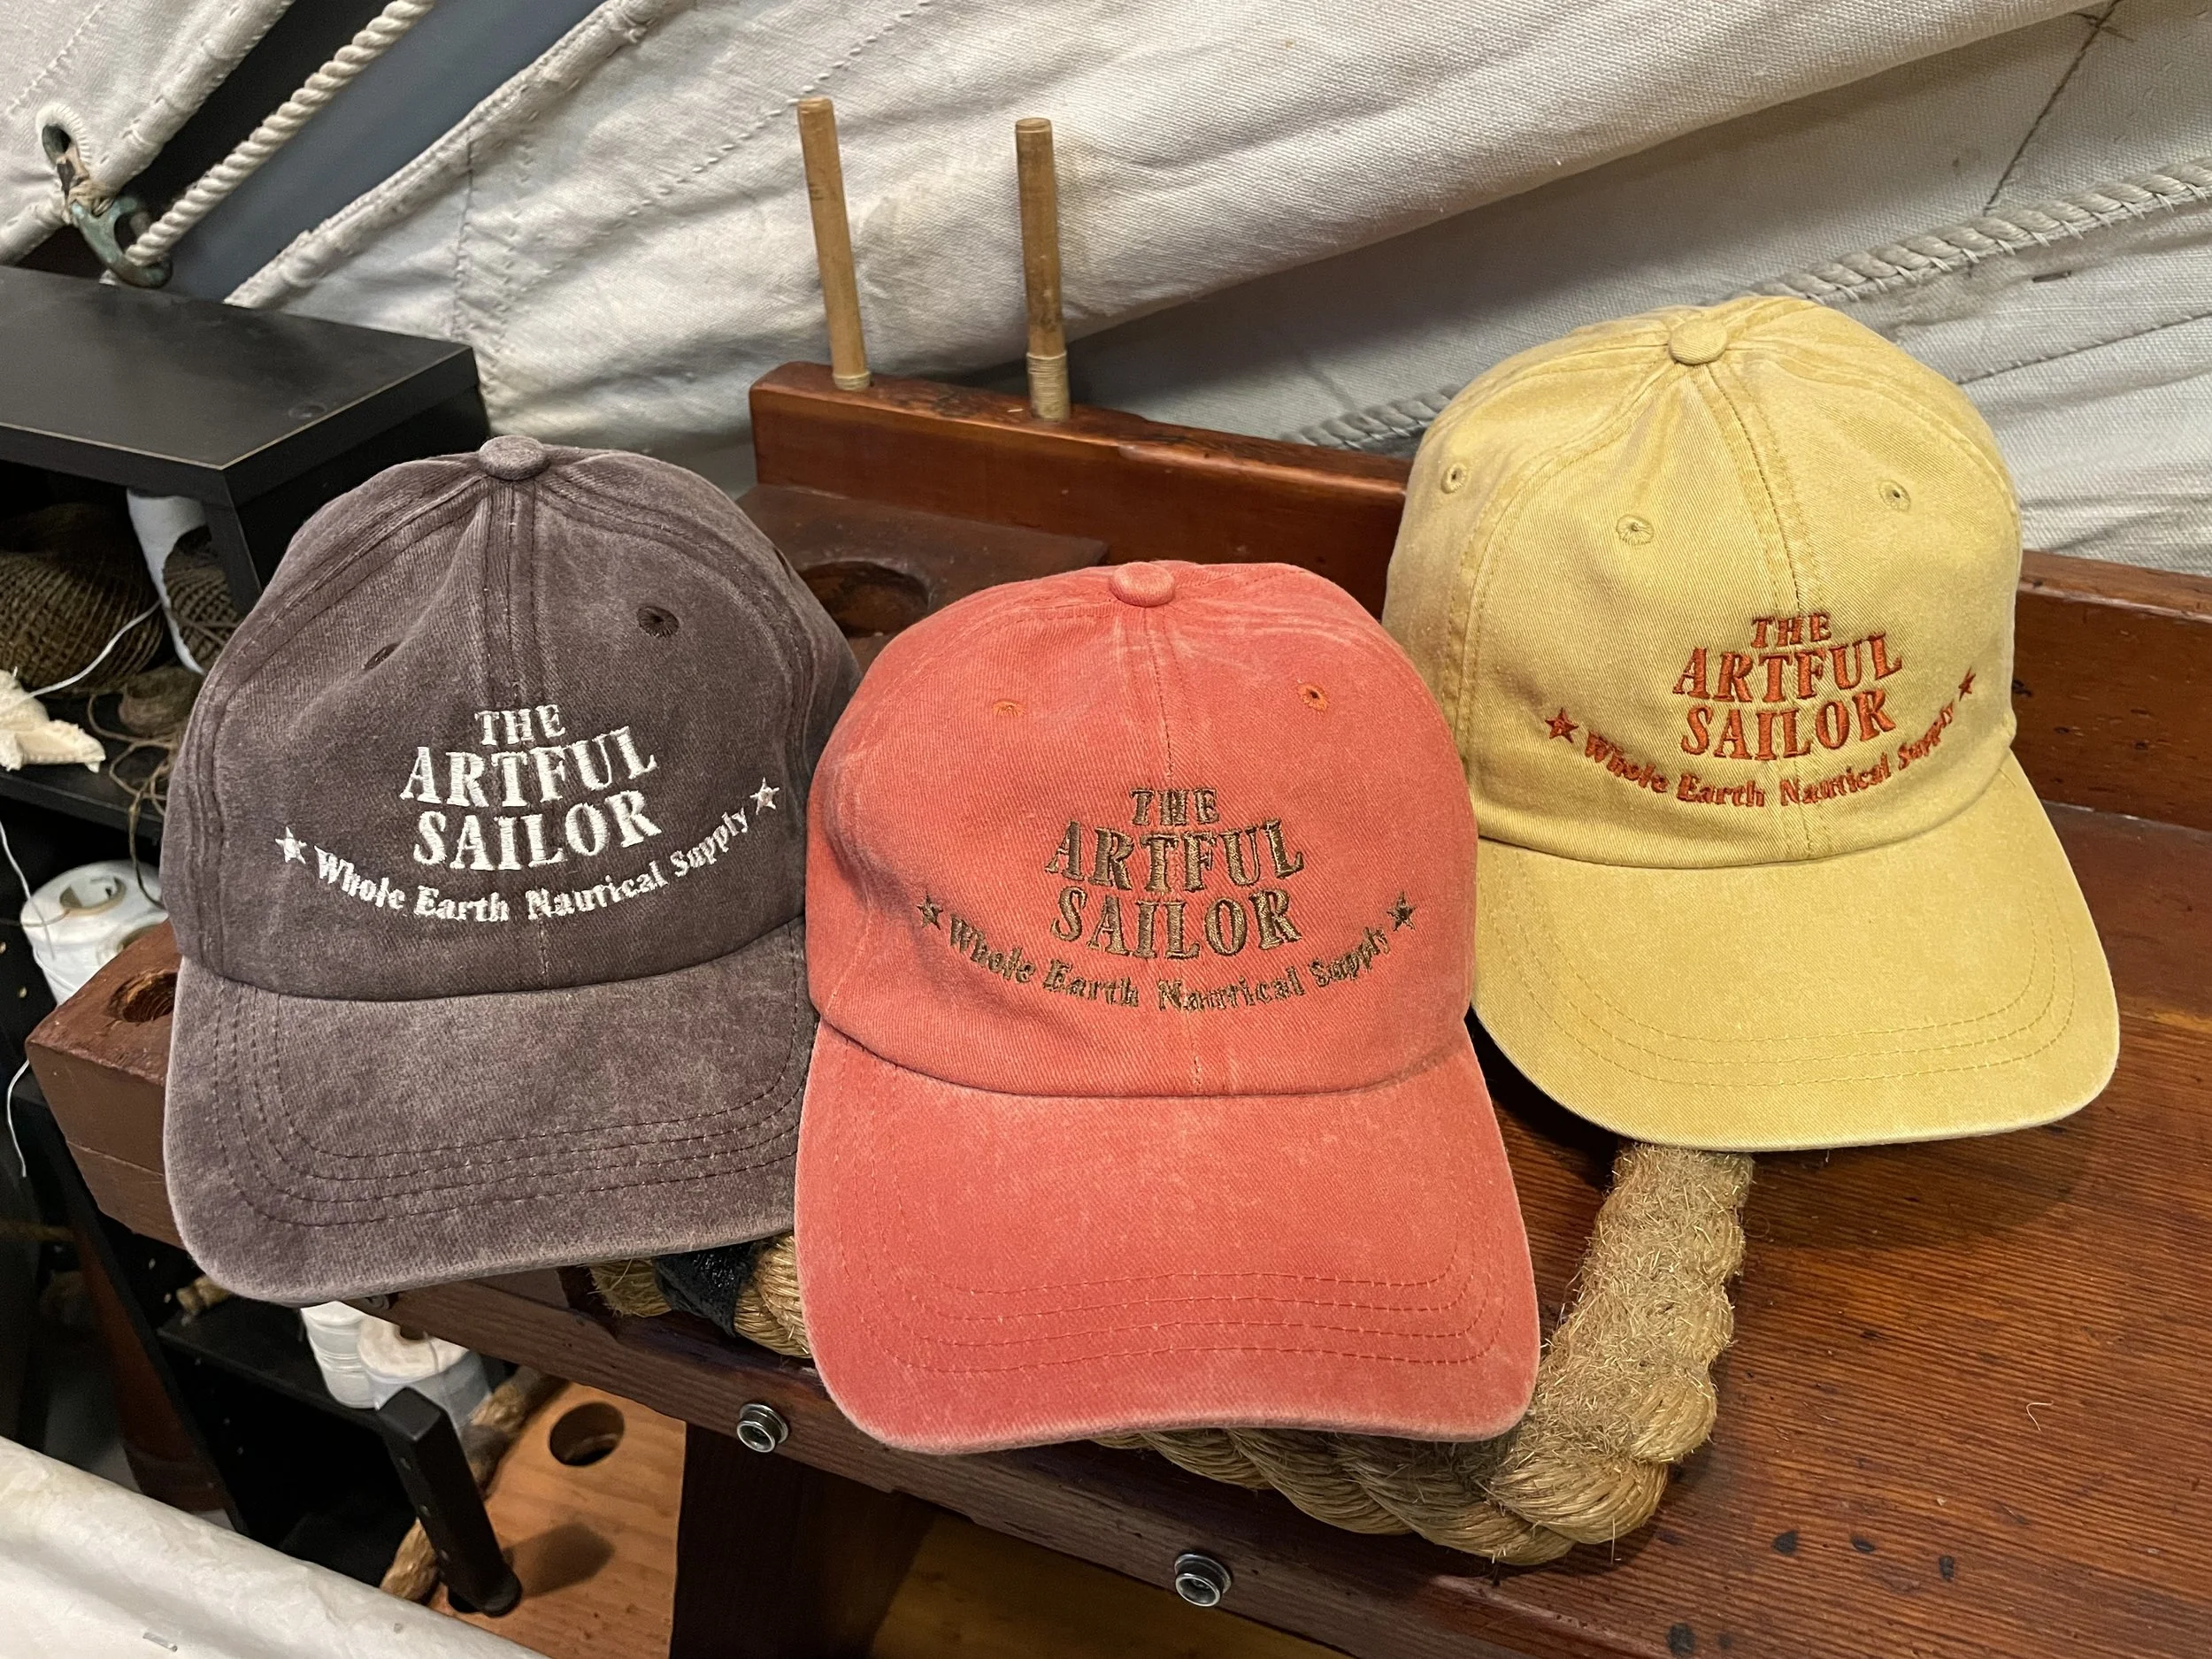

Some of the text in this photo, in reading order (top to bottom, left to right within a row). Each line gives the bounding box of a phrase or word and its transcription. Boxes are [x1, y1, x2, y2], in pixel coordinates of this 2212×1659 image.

[1751, 612, 1832, 648] THE
[1672, 633, 1902, 703] ARTFUL
[475, 704, 565, 745] THE
[1681, 689, 1896, 761] SAILOR
[400, 726, 657, 808] ARTFUL
[1585, 731, 1669, 794] Whole
[1677, 773, 1764, 807] Earth
[1779, 752, 1892, 806] Nautical
[413, 790, 662, 871] SAILOR
[1129, 788, 1220, 826] THE
[314, 808, 749, 922] Whole Earth Nautical Supply
[1045, 818, 1304, 892] ARTFUL
[1051, 887, 1302, 960] SAILOR
[949, 914, 1389, 1011] Whole Earth Nautical Supply
